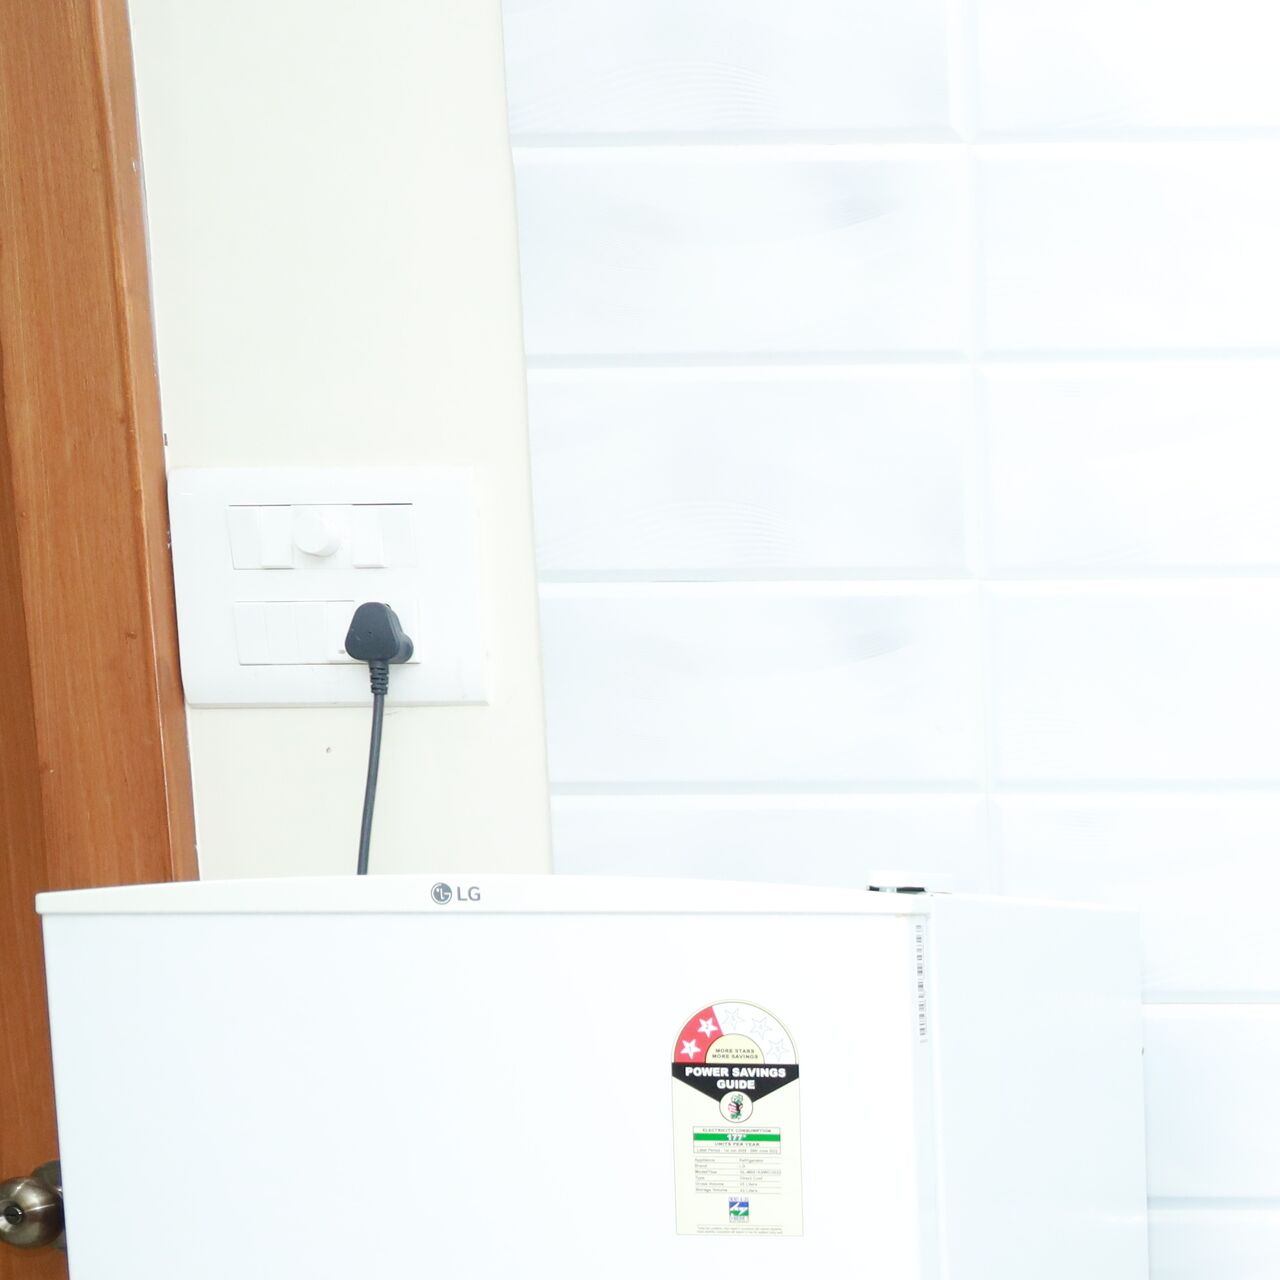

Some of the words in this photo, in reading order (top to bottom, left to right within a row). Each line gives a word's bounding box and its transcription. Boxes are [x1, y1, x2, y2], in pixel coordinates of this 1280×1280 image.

[456, 886, 481, 901] LG
[685, 1067, 729, 1077] POWER
[732, 1068, 786, 1078] SAVINGS
[716, 1079, 756, 1090] GUIDE
